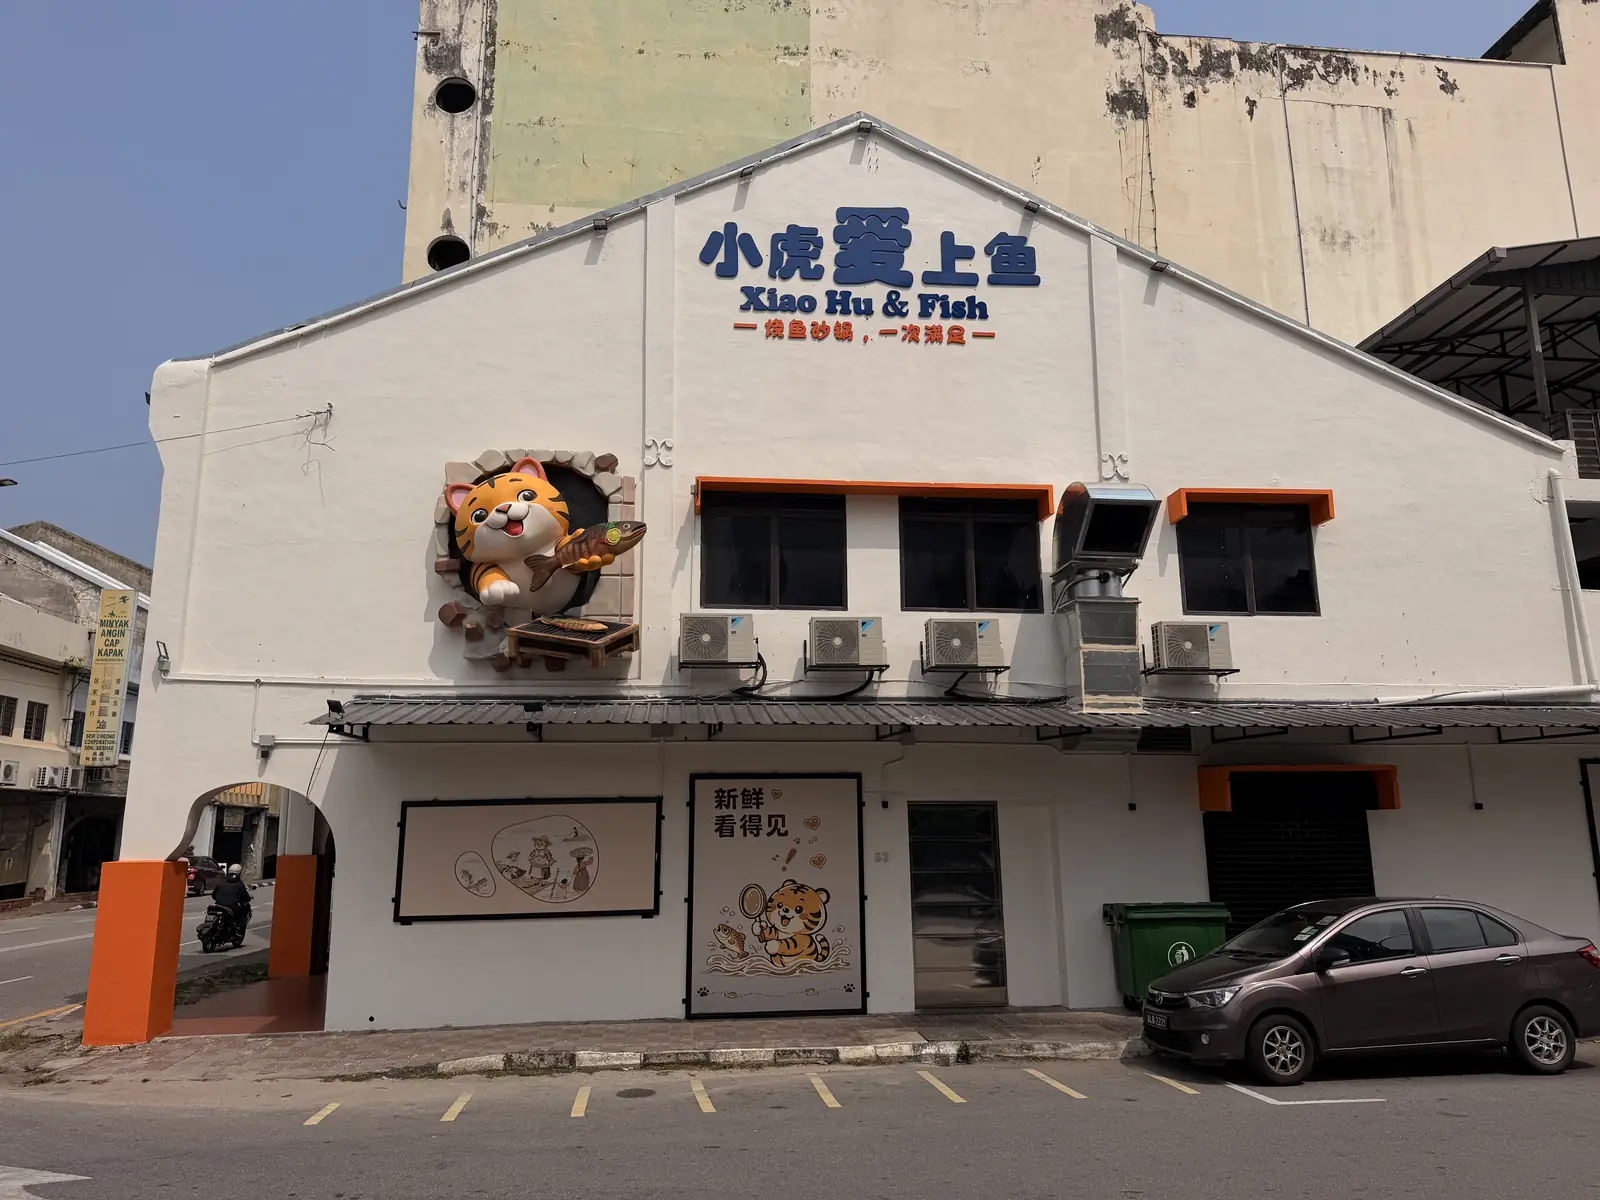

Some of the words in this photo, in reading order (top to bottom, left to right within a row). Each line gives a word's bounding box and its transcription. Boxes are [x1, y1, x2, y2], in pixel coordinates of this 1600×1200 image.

[700, 207, 1040, 288] 小虎爱上鱼
[740, 285, 817, 313] Xiao
[825, 290, 874, 316] Hu
[882, 290, 909, 317] &
[918, 293, 989, 319] Fish
[99, 620, 129, 628] MINYAK
[101, 629, 126, 637] ANGIN
[104, 639, 120, 647] CAP
[97, 648, 124, 657] KAPAK
[713, 787, 765, 811] 新鲜
[713, 814, 789, 839] 看得见
[875, 851, 889, 863] 53
